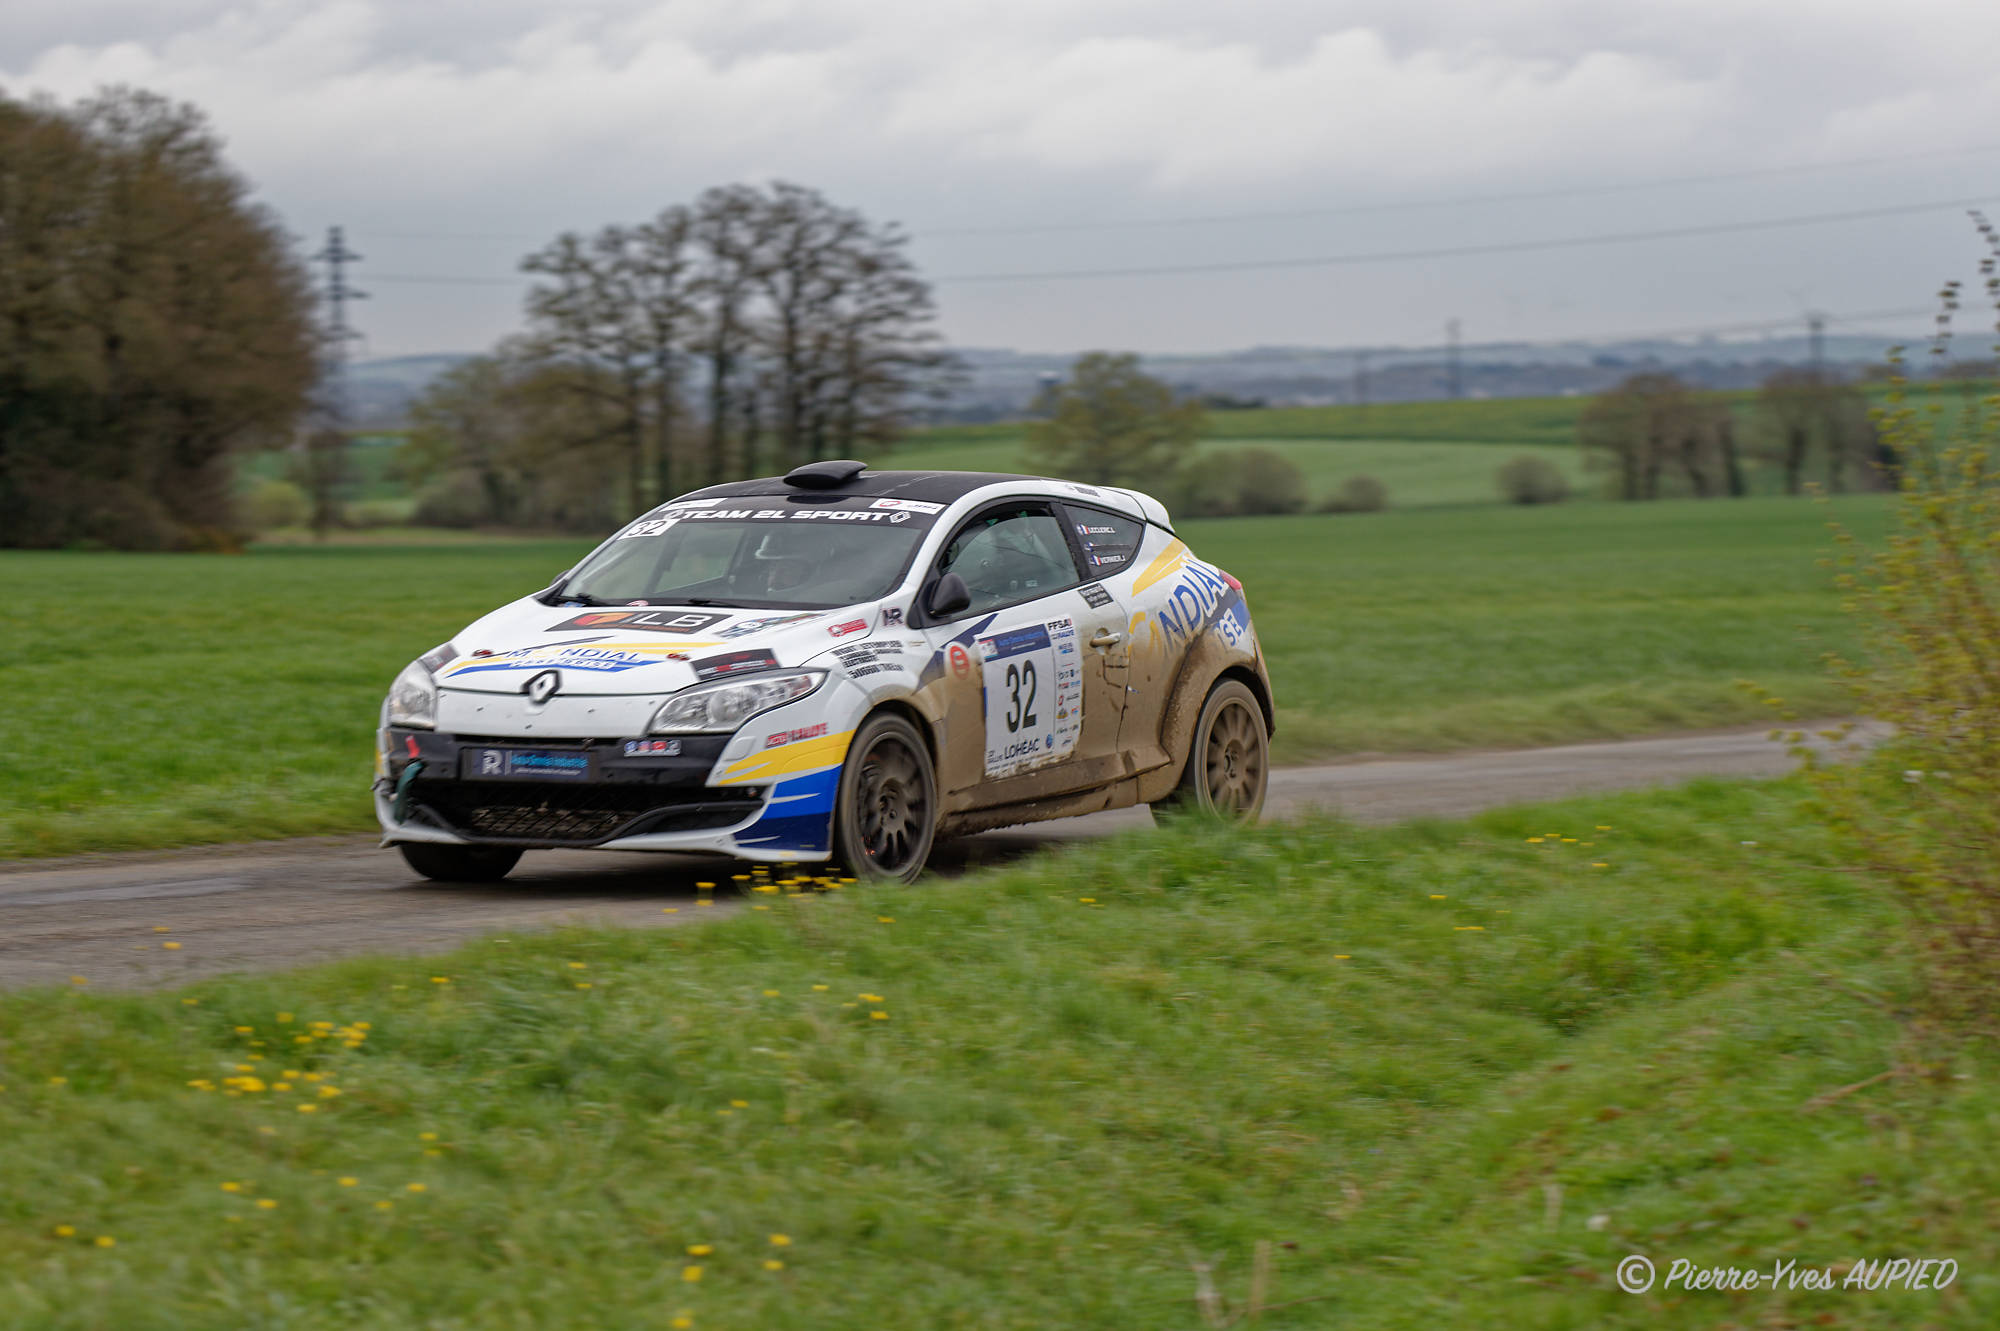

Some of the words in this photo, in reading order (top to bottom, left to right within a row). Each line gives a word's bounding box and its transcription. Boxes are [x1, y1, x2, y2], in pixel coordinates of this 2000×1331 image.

[683, 510, 751, 519] TEAM
[789, 510, 891, 521] SPORT
[627, 520, 667, 537] 32
[632, 612, 713, 628] LB
[1047, 618, 1070, 631] FFSA
[1006, 659, 1037, 733] 32
